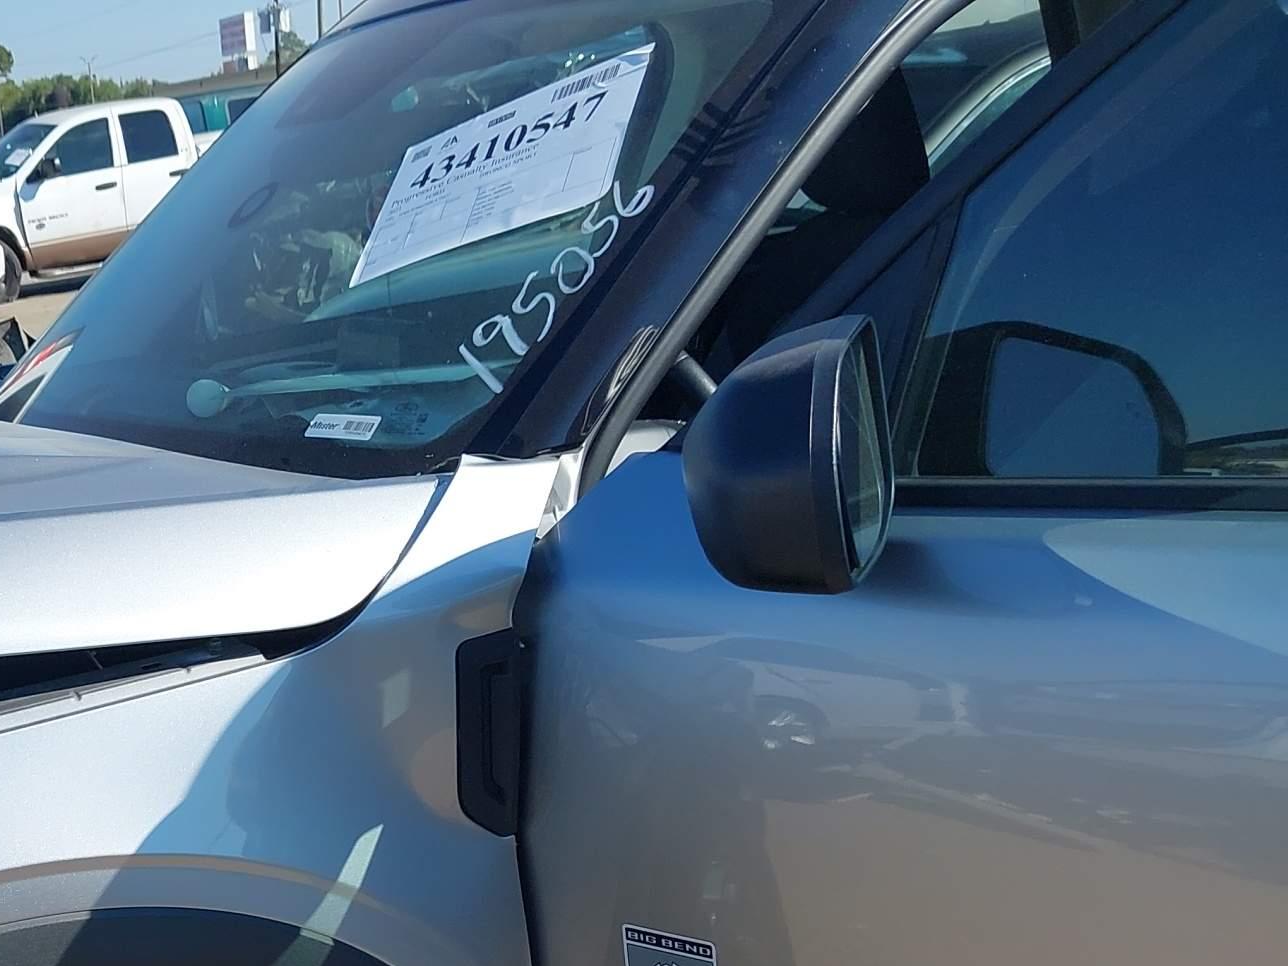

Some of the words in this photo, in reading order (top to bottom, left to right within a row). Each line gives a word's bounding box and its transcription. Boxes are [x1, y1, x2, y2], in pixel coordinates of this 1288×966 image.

[410, 90, 608, 189] 43410547
[459, 180, 654, 394] 195056
[310, 419, 341, 431] Mister
[627, 930, 657, 944] BIG
[661, 938, 711, 957] BEND
